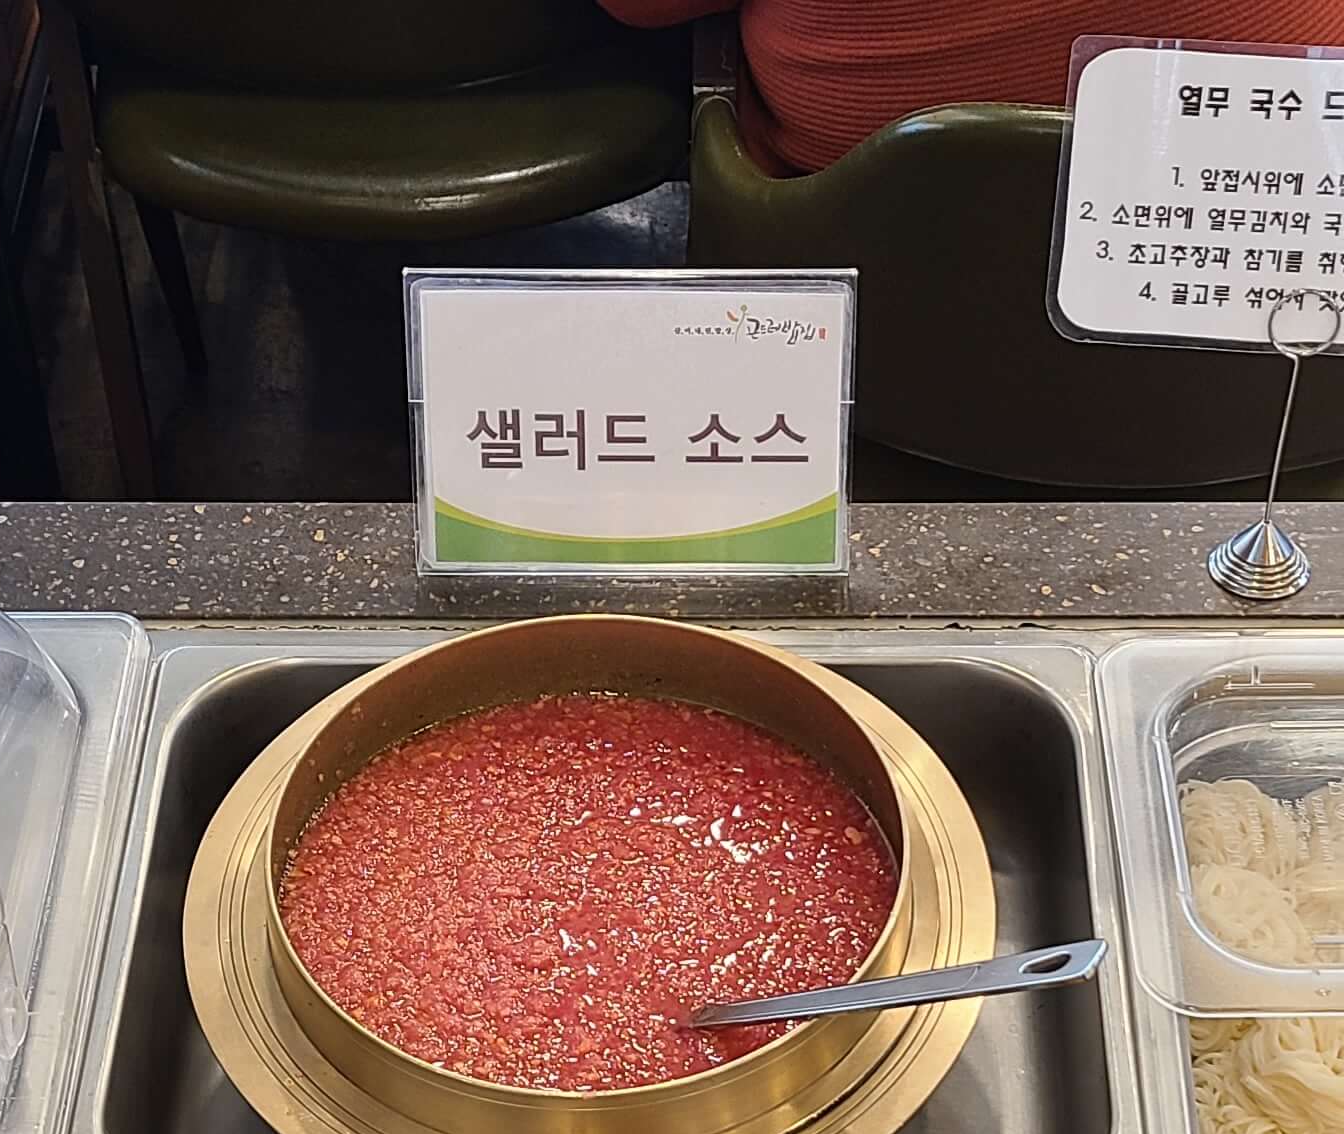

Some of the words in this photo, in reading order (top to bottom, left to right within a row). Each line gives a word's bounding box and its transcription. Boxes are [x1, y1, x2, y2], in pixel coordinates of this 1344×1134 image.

[1179, 84, 1230, 118] 열무
[1250, 88, 1304, 121] 국수
[1171, 166, 1185, 188] 1.
[1200, 168, 1305, 196] 앞접시위에
[1079, 201, 1098, 222] 2.
[1112, 203, 1194, 230] 소면위에
[1207, 207, 1311, 235] 열무김치와
[1096, 240, 1114, 261] 3.
[1128, 243, 1231, 270] 초고추장과
[1243, 248, 1304, 273] 참기름
[1138, 281, 1157, 301] 4.
[1171, 282, 1231, 307] 골고루
[466, 408, 656, 471] 샐러드
[685, 413, 810, 463] 소스
